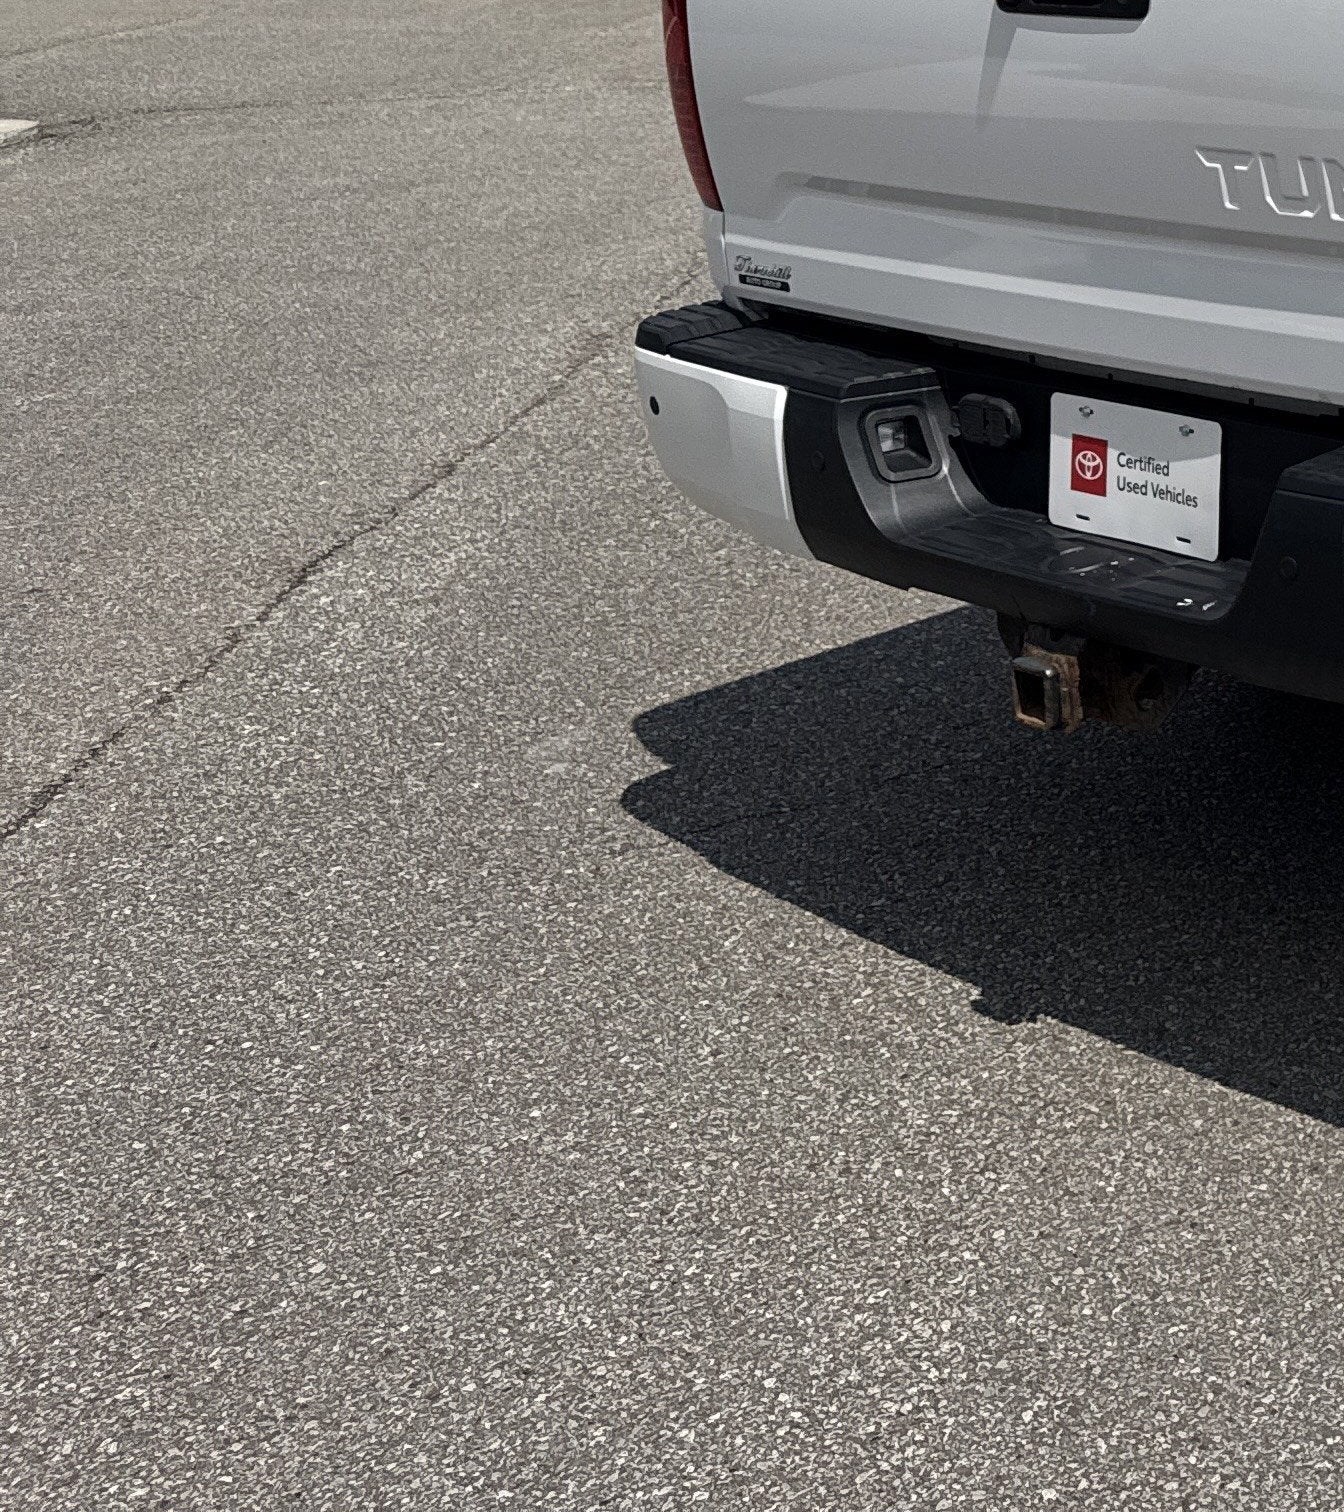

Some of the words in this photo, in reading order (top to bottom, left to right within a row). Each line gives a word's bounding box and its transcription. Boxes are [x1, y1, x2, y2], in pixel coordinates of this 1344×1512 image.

[1116, 451, 1170, 477] Certified
[1116, 475, 1148, 496] Used
[1150, 481, 1199, 508] Vehicles
